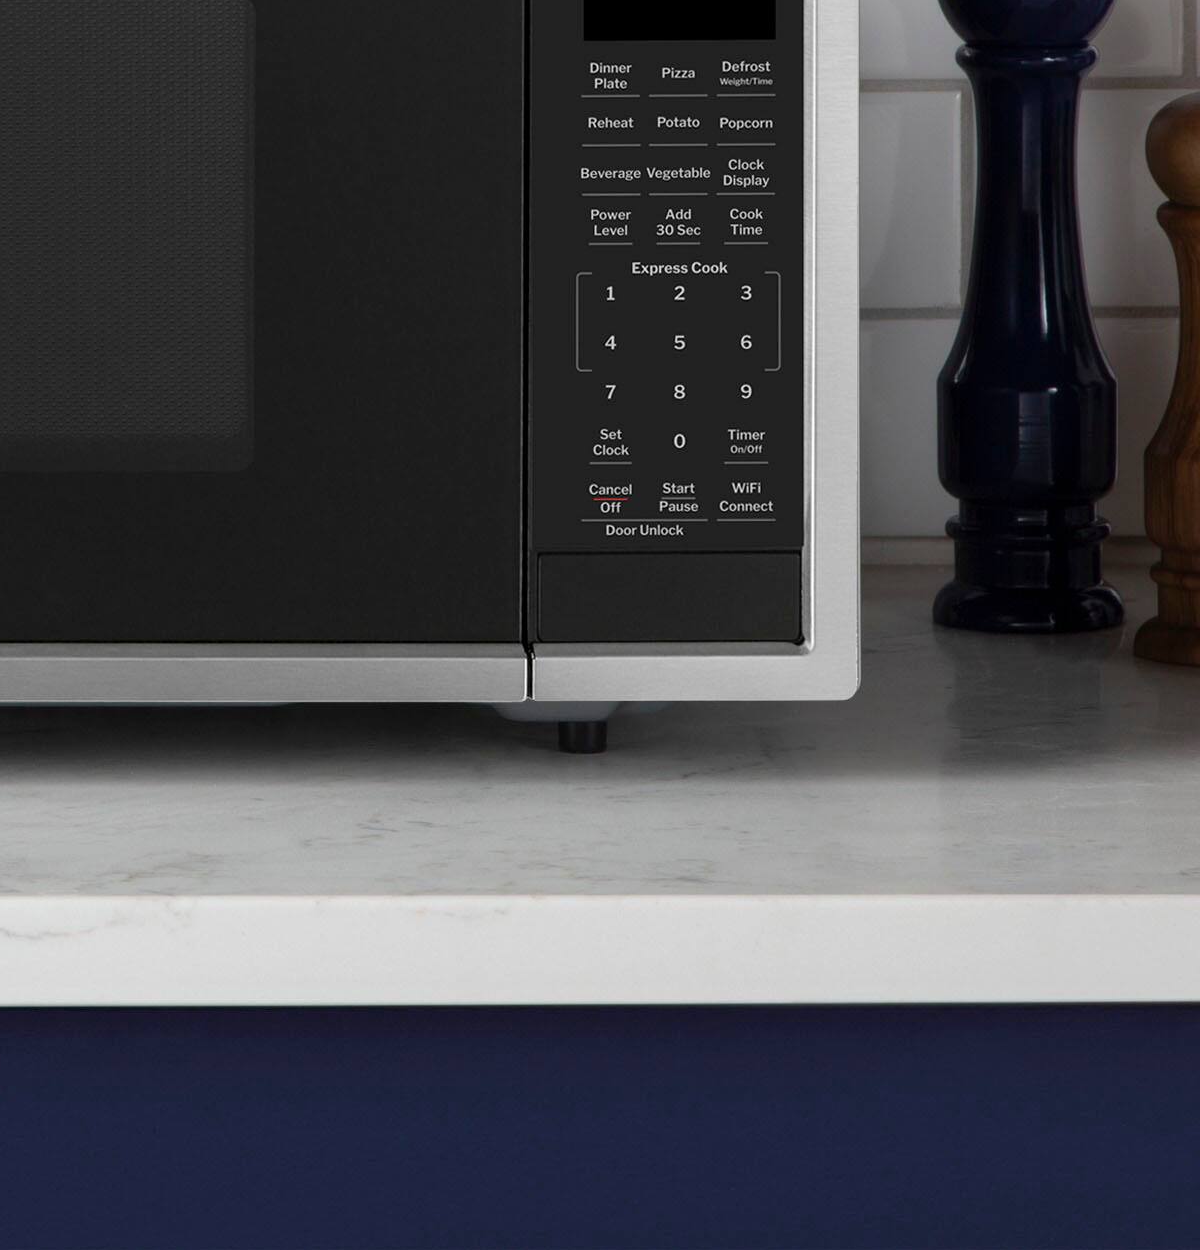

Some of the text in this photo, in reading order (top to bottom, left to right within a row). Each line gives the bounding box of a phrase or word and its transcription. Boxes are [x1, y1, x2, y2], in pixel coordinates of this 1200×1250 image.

[590, 63, 632, 73] Dinner
[722, 61, 770, 72] Defrost
[662, 67, 695, 78] Pizza
[595, 78, 627, 89] Plate
[720, 78, 773, 86] Weight/Time
[588, 117, 633, 128] Reheat
[658, 117, 700, 127] Potato
[720, 118, 773, 130] Popcorn
[728, 159, 764, 170] Clock
[581, 168, 641, 181] Beverage
[647, 167, 710, 180] Vegetable
[724, 175, 769, 187] Display
[591, 209, 631, 220] Power
[666, 209, 691, 219] Add
[730, 209, 763, 219] Cook
[594, 225, 627, 236] Level
[657, 224, 700, 235] 30 Sec
[731, 224, 762, 235] Time
[632, 262, 727, 276] Express Cook
[607, 286, 615, 300] 1
[674, 286, 685, 300] 2
[741, 285, 752, 300] 3
[605, 335, 616, 350] 4
[674, 335, 685, 349] 5
[741, 335, 752, 349] 6
[606, 385, 616, 399] 7
[674, 385, 685, 399] 8
[741, 384, 752, 399] 9
[600, 429, 622, 440] Set
[728, 429, 765, 440] Timer
[674, 434, 685, 448] 0
[593, 444, 629, 455] Clock
[731, 445, 762, 453] On/Off
[589, 484, 632, 495] Cancel
[663, 483, 694, 494] Start
[732, 483, 761, 493] WiFi
[600, 502, 621, 513] Off
[660, 501, 698, 512] Pause
[720, 501, 773, 511] Connect
[606, 525, 683, 535] Door Unlock
